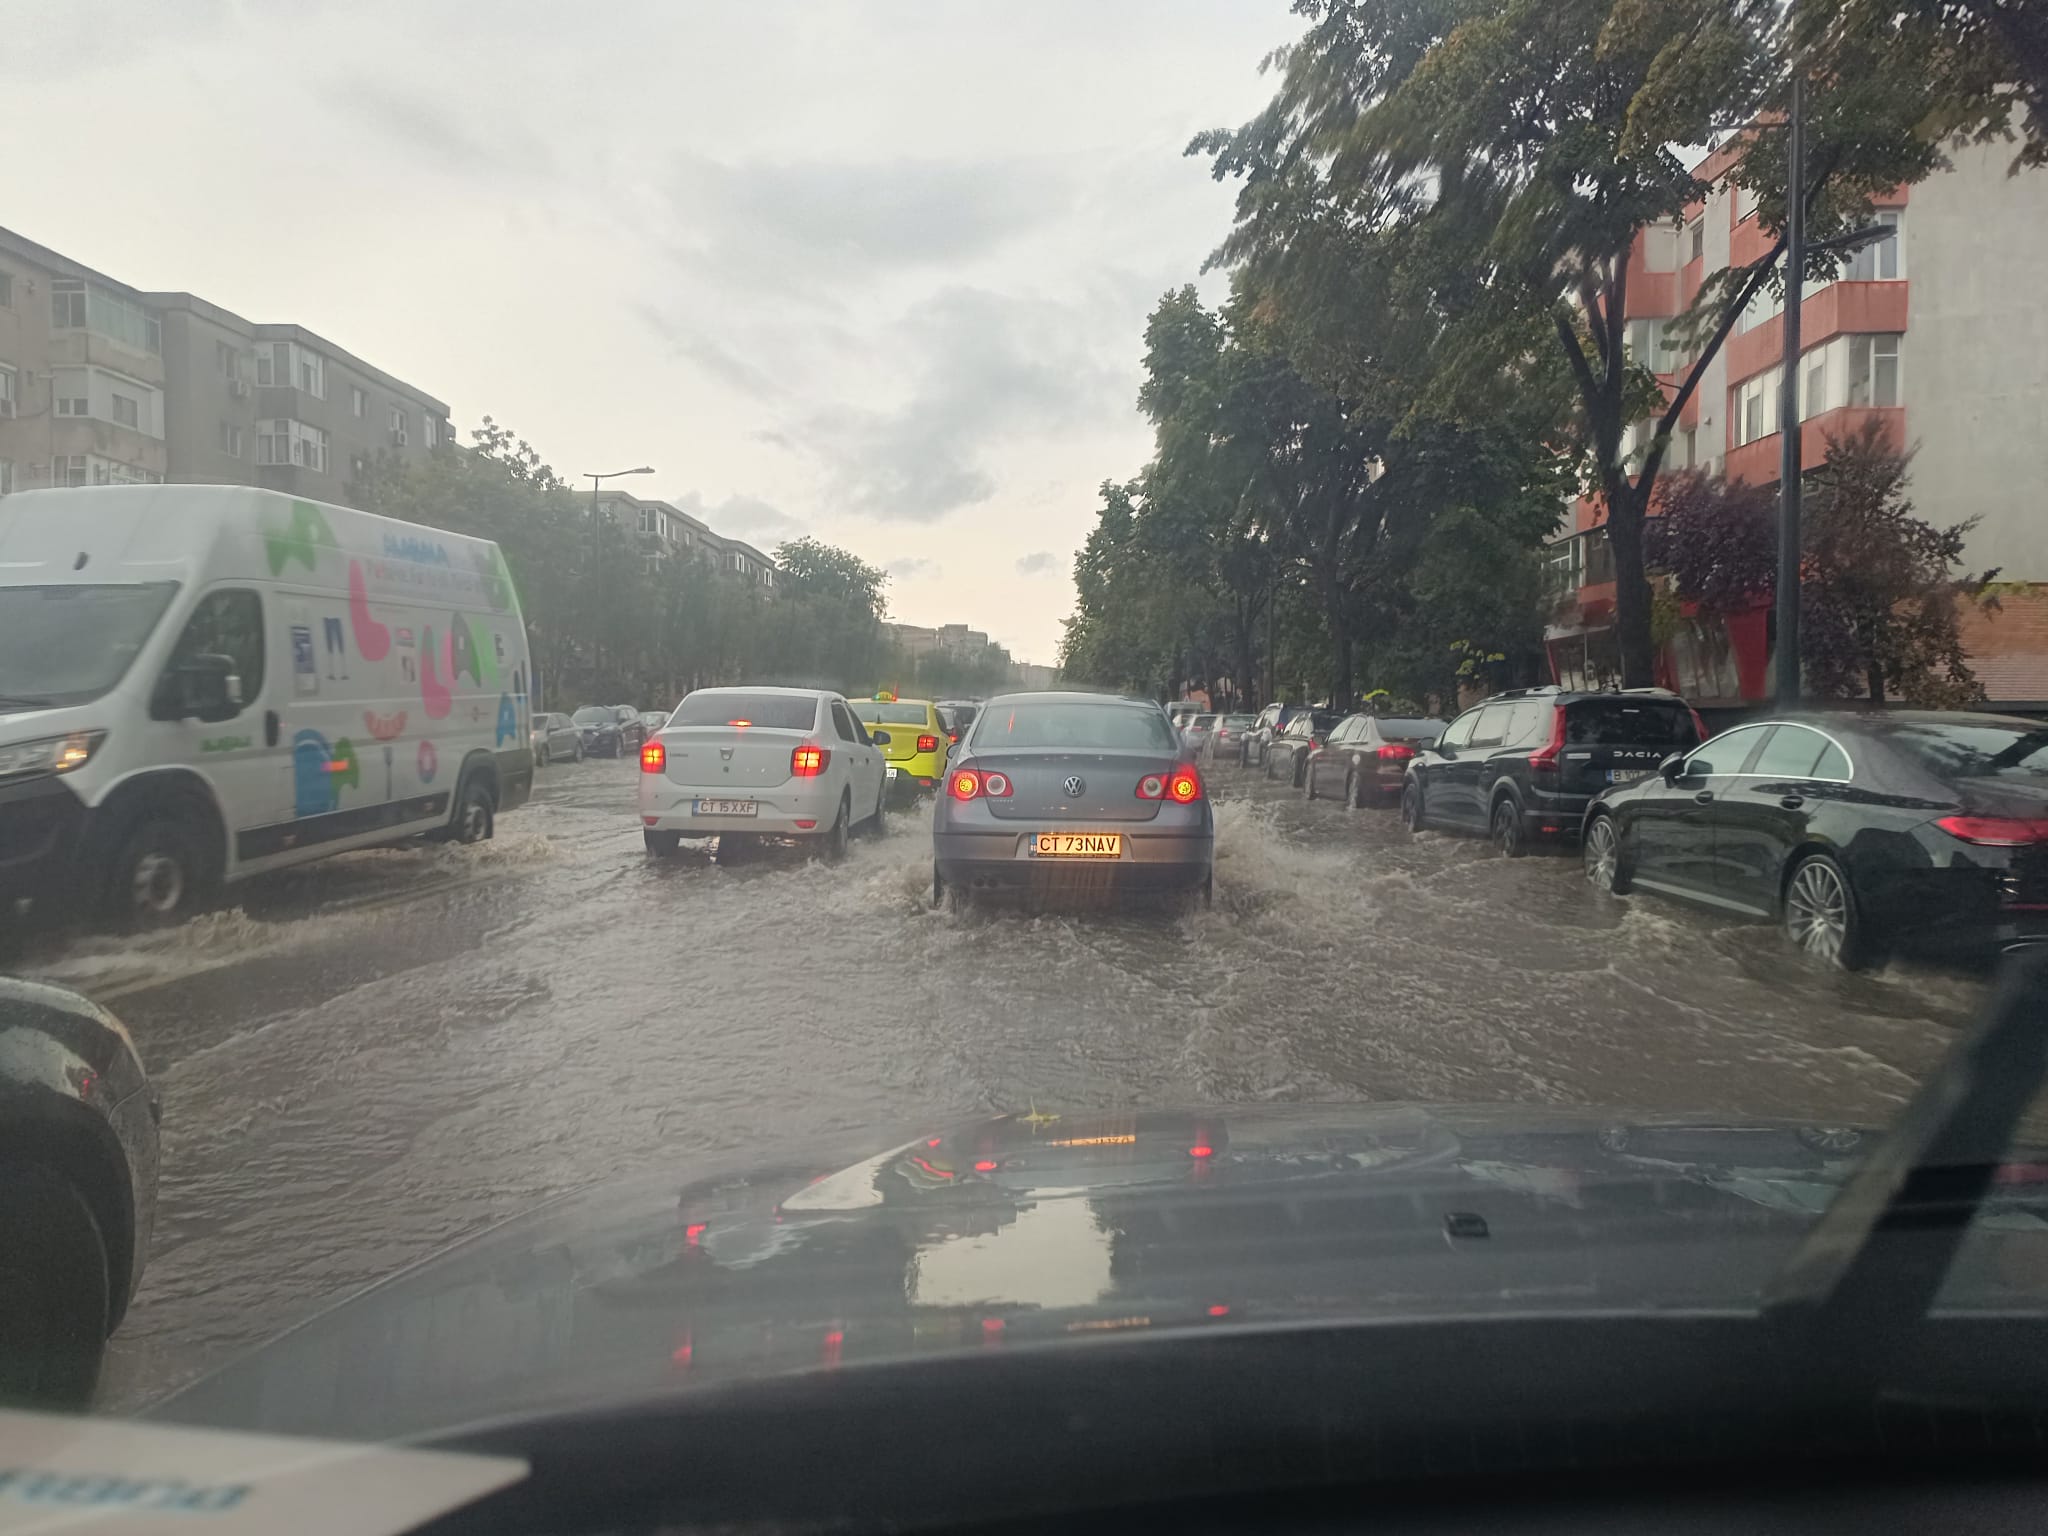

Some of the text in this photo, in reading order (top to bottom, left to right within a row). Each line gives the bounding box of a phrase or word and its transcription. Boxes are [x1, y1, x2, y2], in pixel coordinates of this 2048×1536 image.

[1613, 750, 1662, 759] DACIA
[700, 802, 754, 813] CT 15 XXF
[1040, 837, 1060, 851] CT
